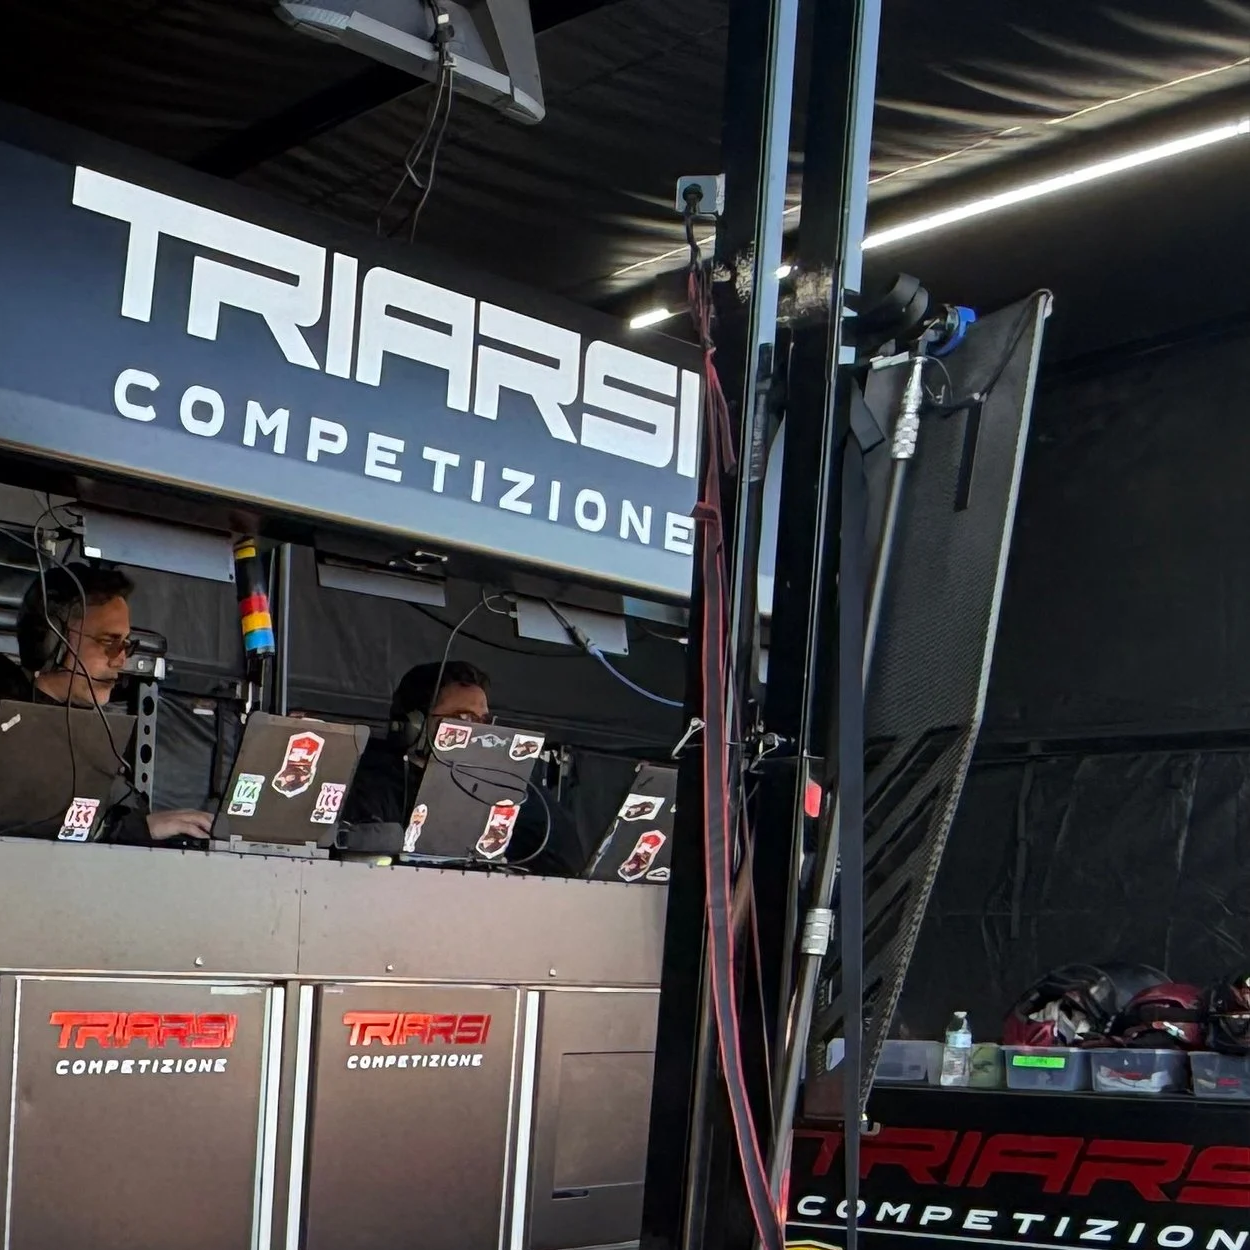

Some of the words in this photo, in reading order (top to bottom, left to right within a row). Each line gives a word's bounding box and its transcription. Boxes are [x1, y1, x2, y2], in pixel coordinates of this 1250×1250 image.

[72, 165, 700, 479] TRIARSI
[113, 368, 695, 556] COMPETIZIONE
[50, 1011, 238, 1049] TRIARSI
[343, 1011, 491, 1046] TRIARSI
[55, 1058, 228, 1075] COMPETIZIONE
[347, 1054, 483, 1069] COMPETIZIONE
